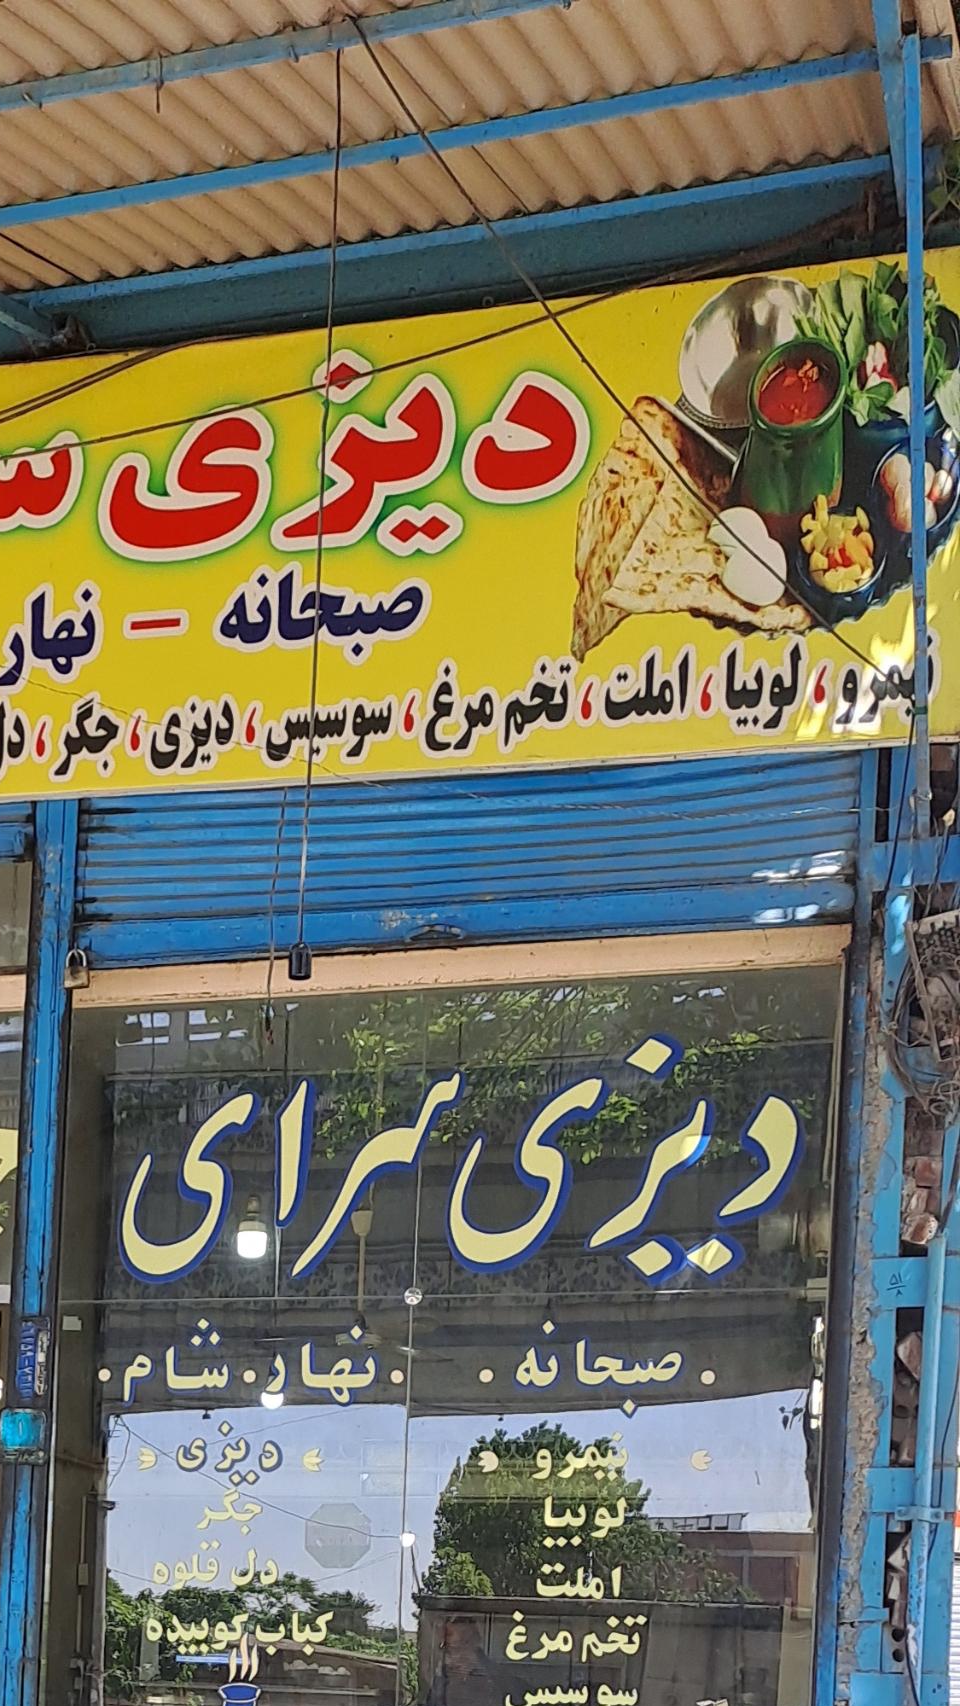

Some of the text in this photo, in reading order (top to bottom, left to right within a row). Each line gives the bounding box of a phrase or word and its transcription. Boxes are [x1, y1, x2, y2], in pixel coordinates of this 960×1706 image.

[102, 357, 585, 556] دیزی
[218, 567, 426, 658] صبحانه
[503, 660, 572, 747] تخم
[120, 1036, 802, 1282] دیزی سرای
[121, 1319, 229, 1402] شام
[264, 1325, 377, 1405] نهار
[515, 1320, 683, 1416] صبحانه
[177, 1421, 282, 1486] دیزی
[531, 1431, 628, 1481] نیمرو
[196, 1487, 264, 1535] جگر
[542, 1495, 628, 1549] لوبیا
[153, 1538, 279, 1591] دل قلوه
[535, 1562, 623, 1600] املت
[145, 1610, 335, 1656] کباب کوبیده
[505, 1609, 648, 1663] تخم مرغ
